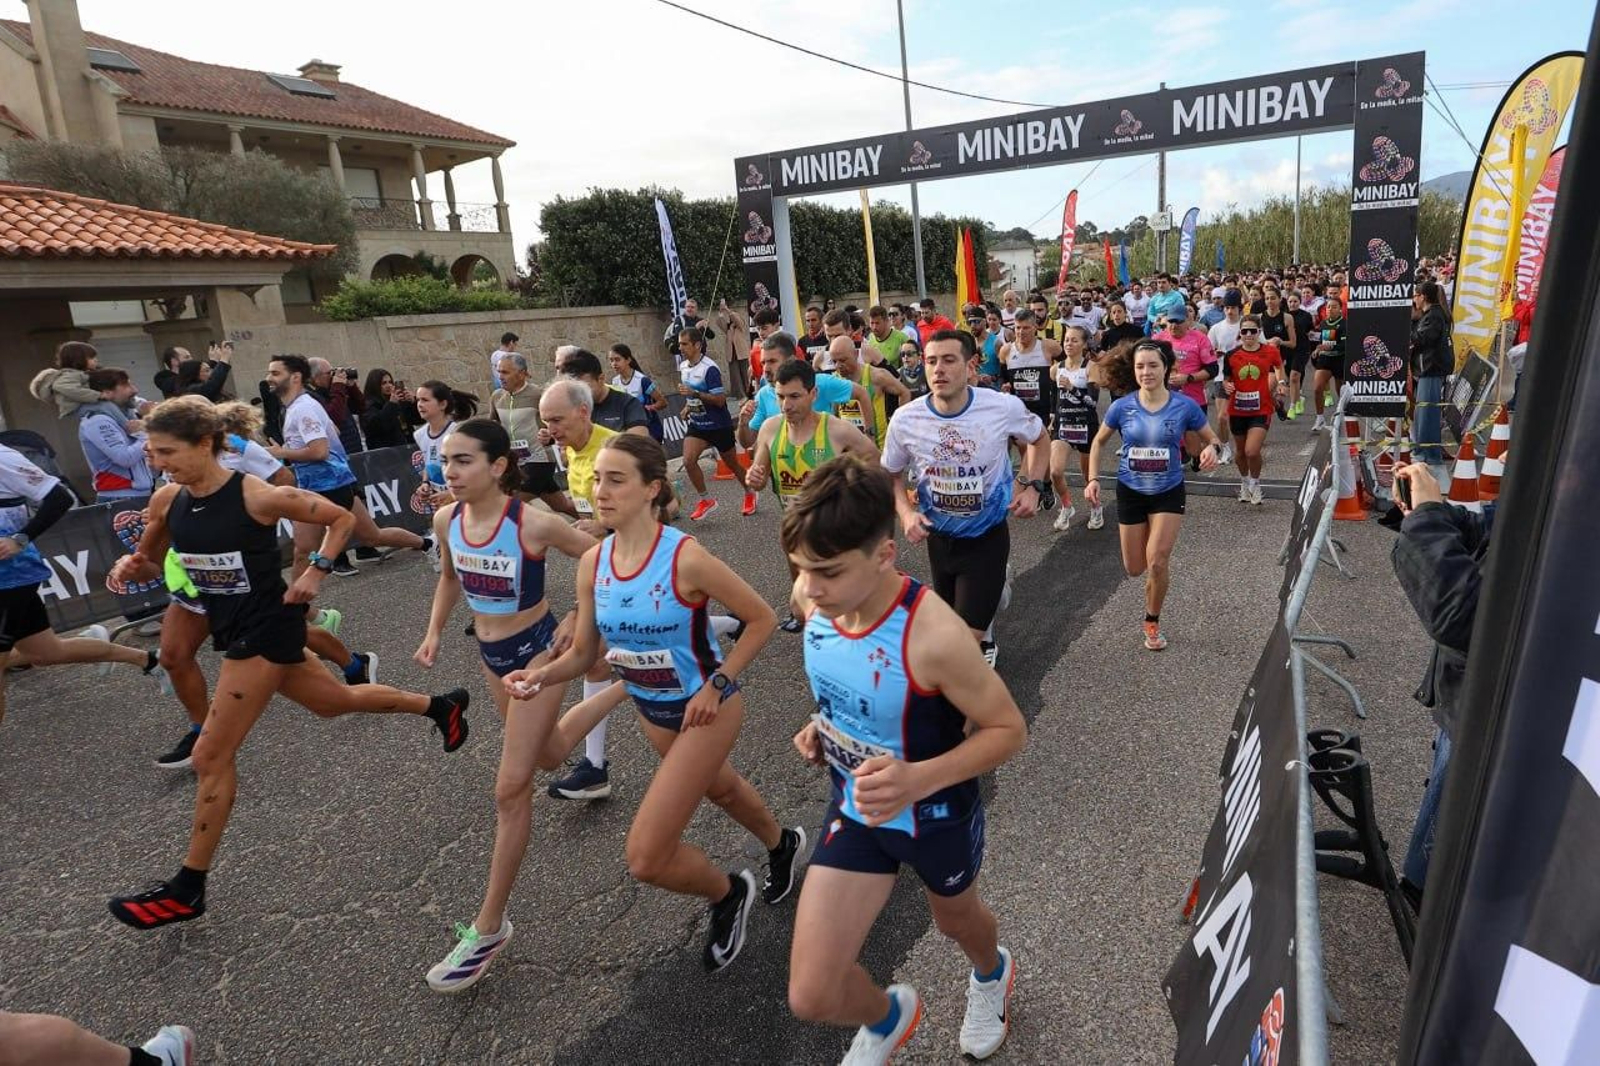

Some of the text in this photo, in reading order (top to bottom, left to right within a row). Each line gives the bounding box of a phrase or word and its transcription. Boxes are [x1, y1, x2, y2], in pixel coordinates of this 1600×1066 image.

[1173, 77, 1334, 135] MINIBAY
[958, 113, 1085, 164] MINIBAY
[781, 144, 883, 187] MINIBAY
[1353, 182, 1417, 201] MINIBAY
[743, 244, 776, 257] MINIBAY
[1349, 283, 1412, 300] MINIBAY
[1345, 380, 1406, 394] MINIBAY
[925, 465, 988, 478] MINIBAY
[933, 480, 978, 491] MINIBAY
[938, 494, 976, 507] 10058
[182, 555, 235, 566] MINIBAY
[457, 555, 511, 572] MINIBAY
